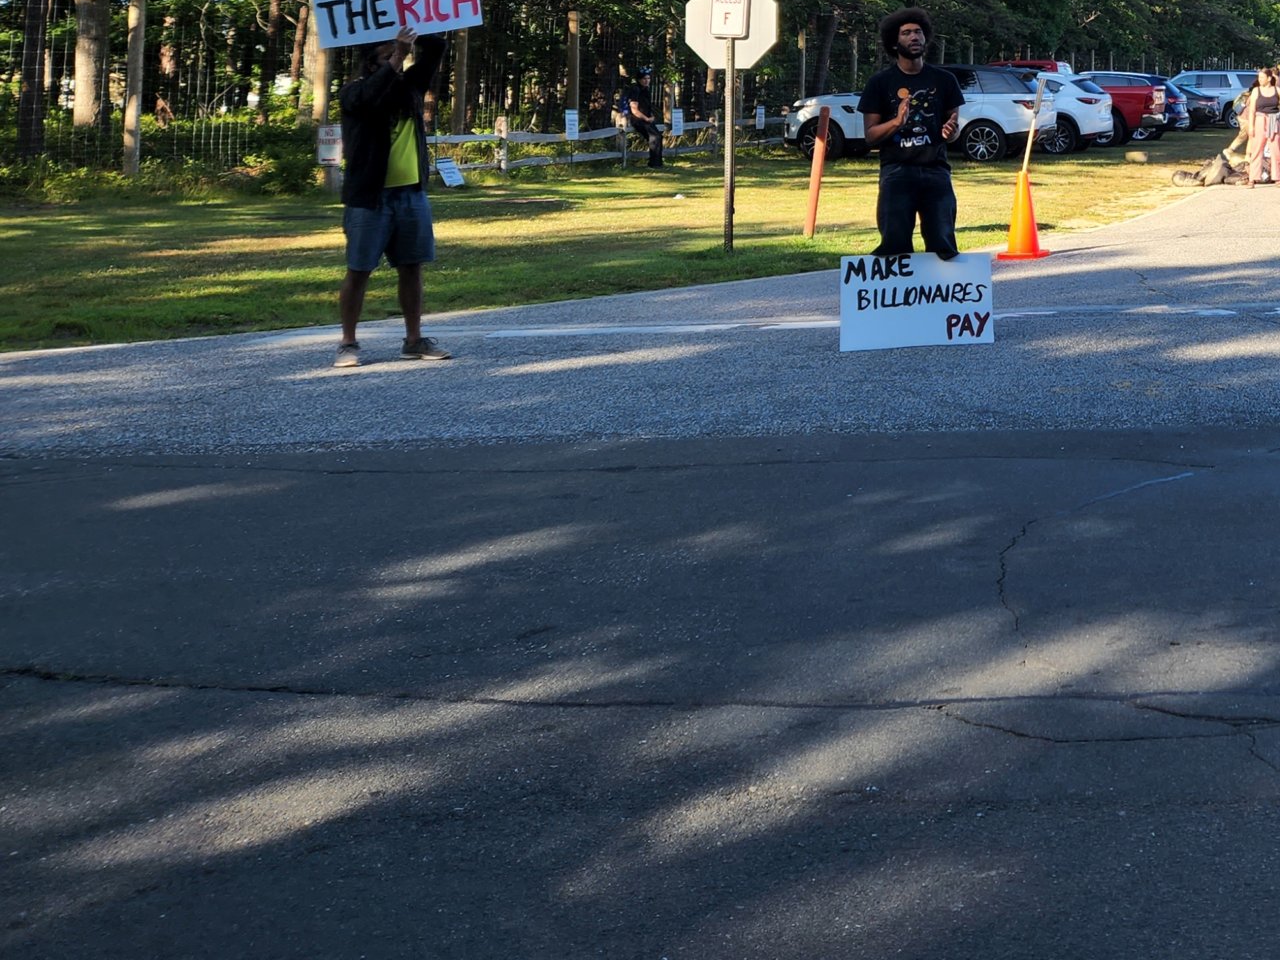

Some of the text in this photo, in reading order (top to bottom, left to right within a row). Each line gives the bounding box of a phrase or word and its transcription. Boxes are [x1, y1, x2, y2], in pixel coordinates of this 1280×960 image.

[723, 11, 731, 25] F
[900, 134, 932, 148] NASA
[844, 254, 914, 285] MAKE
[857, 282, 988, 311] BILLIONAIRES
[946, 311, 990, 340] PAY
